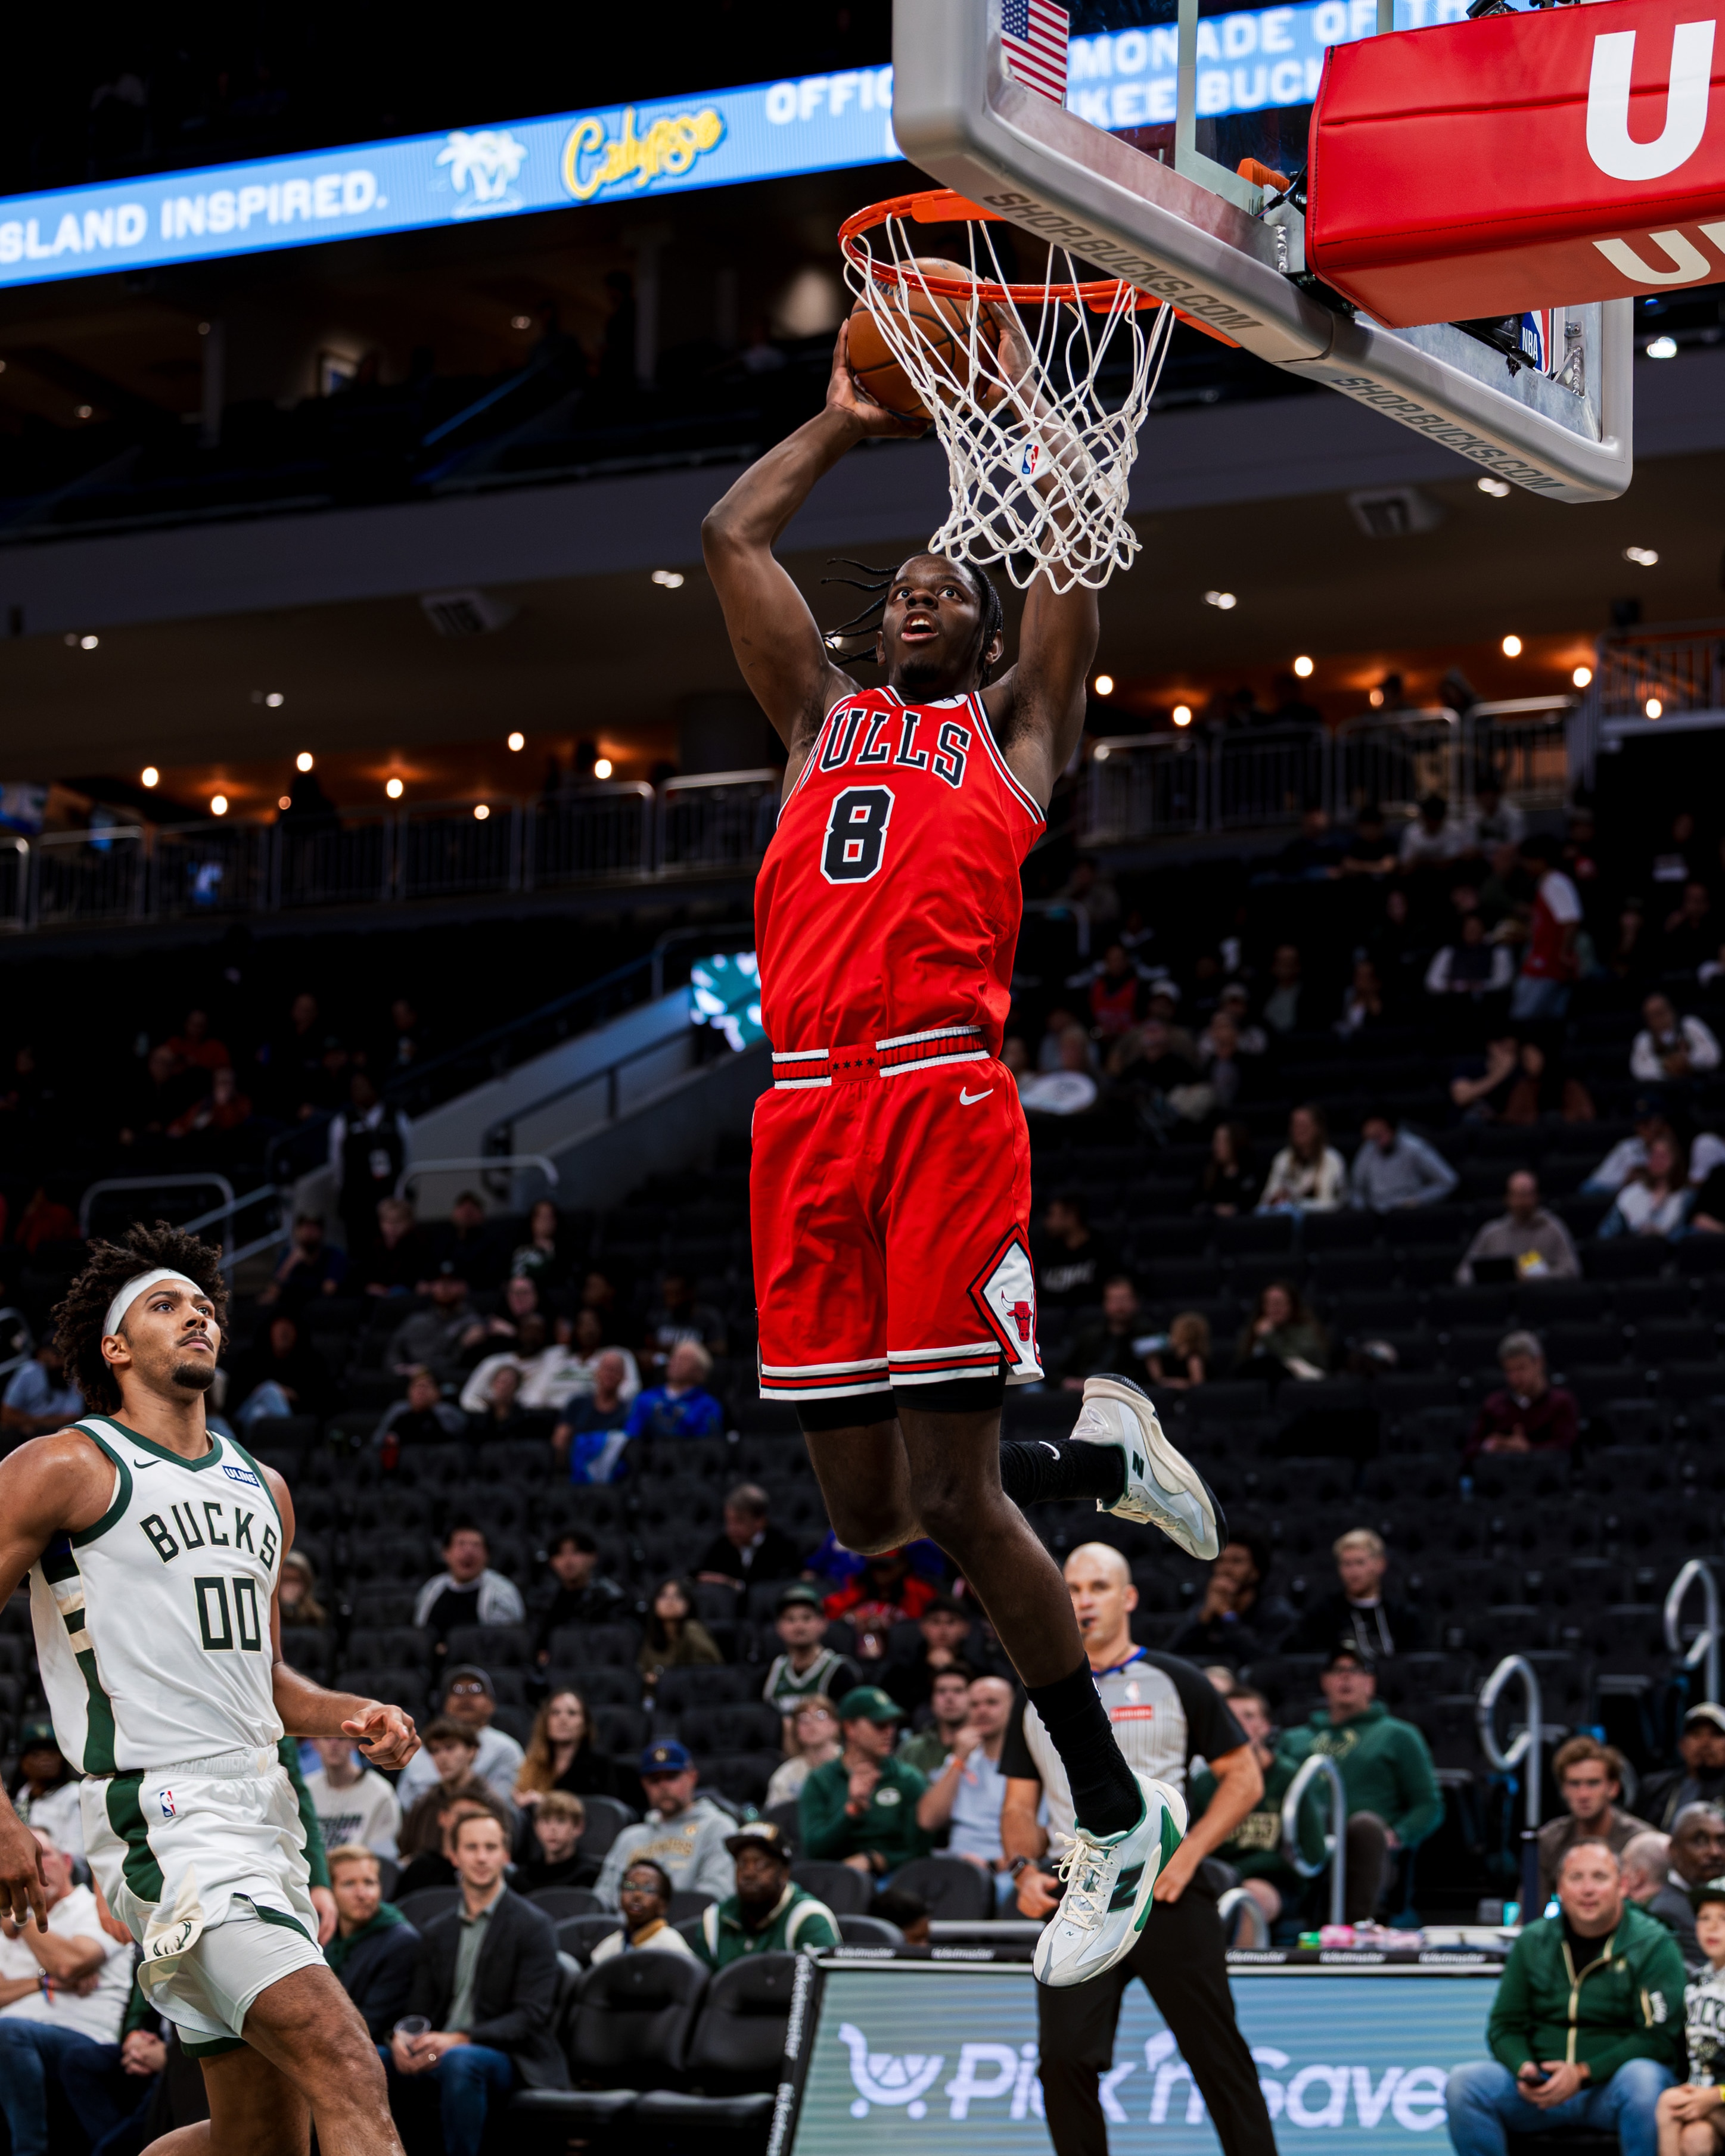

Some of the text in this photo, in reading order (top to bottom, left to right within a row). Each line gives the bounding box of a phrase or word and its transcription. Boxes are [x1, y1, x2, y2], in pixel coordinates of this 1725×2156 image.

[1586, 20, 1716, 181] U
[160, 169, 388, 239] INSPIRED.
[983, 191, 1264, 331] SHOP.BUCKS.COM
[1592, 221, 1725, 285] U
[1522, 326, 1538, 362] NBA
[1331, 377, 1566, 489] SHOP.BUCKS.COM
[795, 707, 972, 794] ULLS
[819, 785, 896, 885] 8
[224, 1467, 258, 1485] ULINE
[137, 1501, 278, 1572] BUCKS
[192, 1575, 263, 1654] 00
